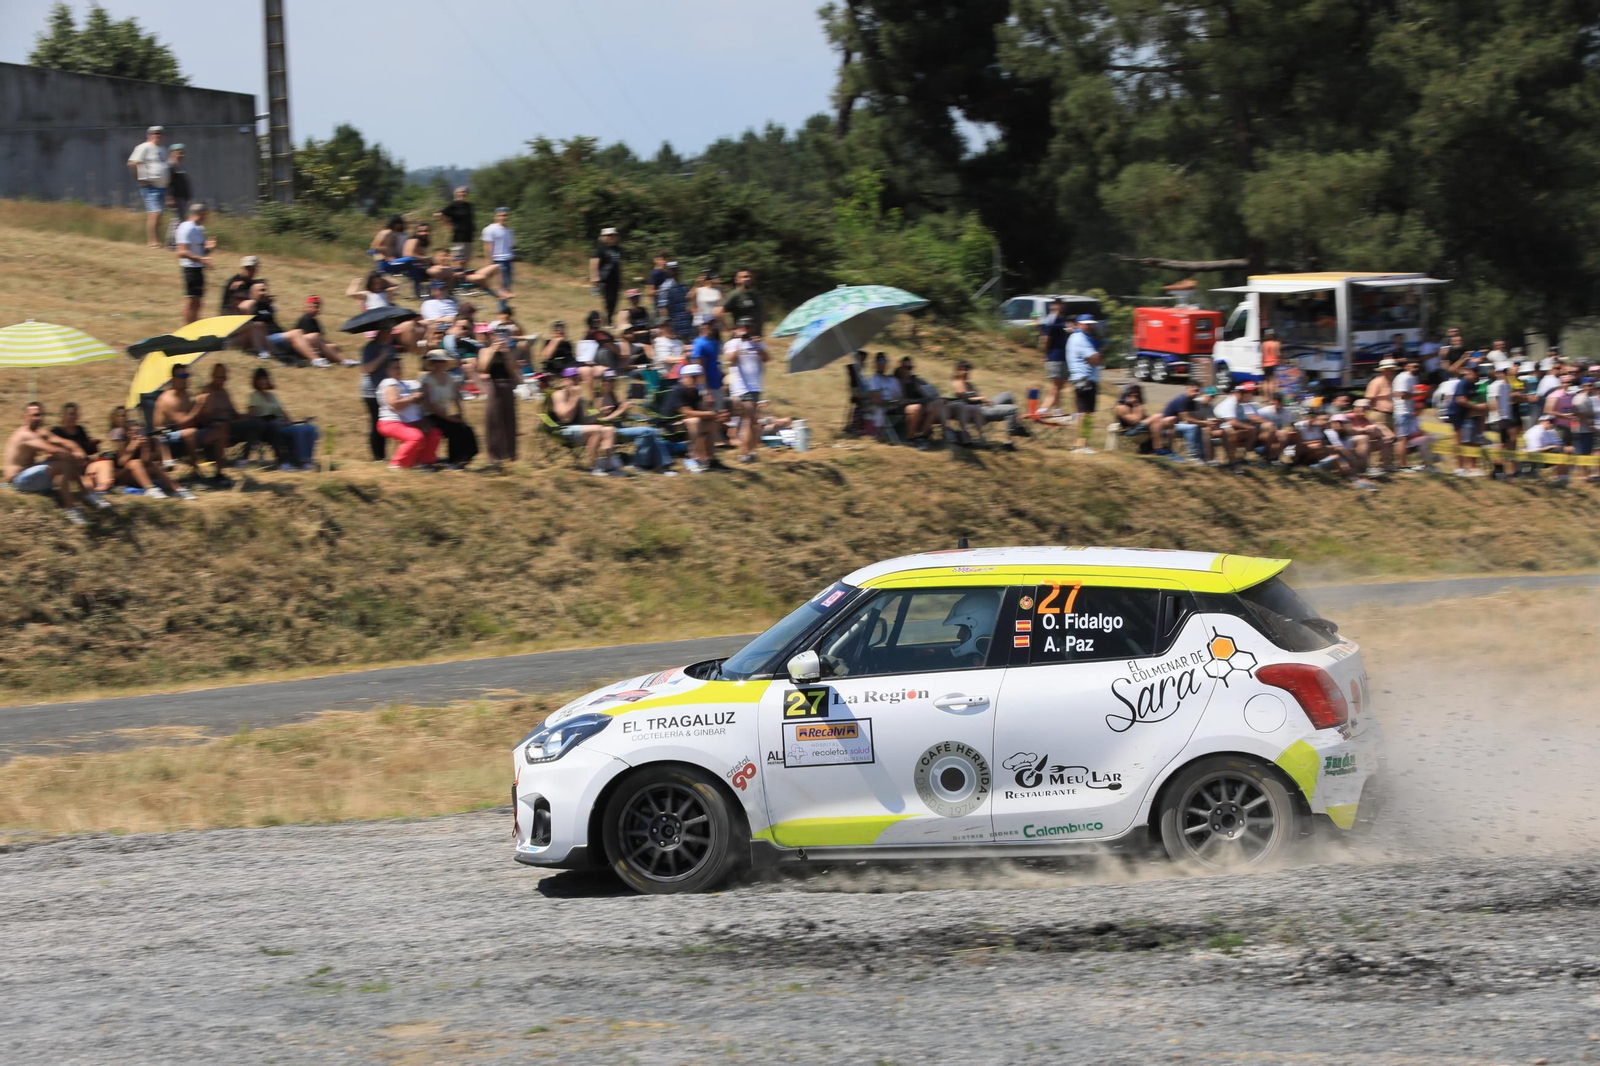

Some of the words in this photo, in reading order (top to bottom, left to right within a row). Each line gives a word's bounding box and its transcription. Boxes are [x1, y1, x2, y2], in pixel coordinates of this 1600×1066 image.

[1037, 580, 1083, 614] 27
[1042, 614, 1060, 630] O.
[1065, 613, 1124, 633] Fidalgo
[1044, 636, 1060, 652] A.
[1066, 636, 1094, 652] Paz
[1127, 660, 1143, 673] EL
[1132, 659, 1189, 683] COLMENAR
[1189, 650, 1207, 664] DE
[787, 690, 826, 716] 27
[832, 692, 858, 705] La
[864, 688, 930, 706] Región
[1105, 668, 1202, 732] Sara
[623, 720, 642, 734] EL
[647, 711, 736, 732] TRAGALUZ
[808, 726, 846, 738] Recalvi
[631, 729, 684, 742] COCTELERÍA
[693, 727, 726, 737] GINBAR
[811, 747, 848, 757] recoletas
[850, 746, 870, 755] salud
[726, 755, 751, 778] cristal
[921, 740, 951, 766] CAFÉ
[956, 743, 990, 794] HERMIDA
[1049, 773, 1084, 785] MEU
[1092, 771, 1122, 783] LAR
[916, 777, 944, 813] DESDE
[949, 802, 975, 816] 1974
[1023, 821, 1104, 838] Calambuco
